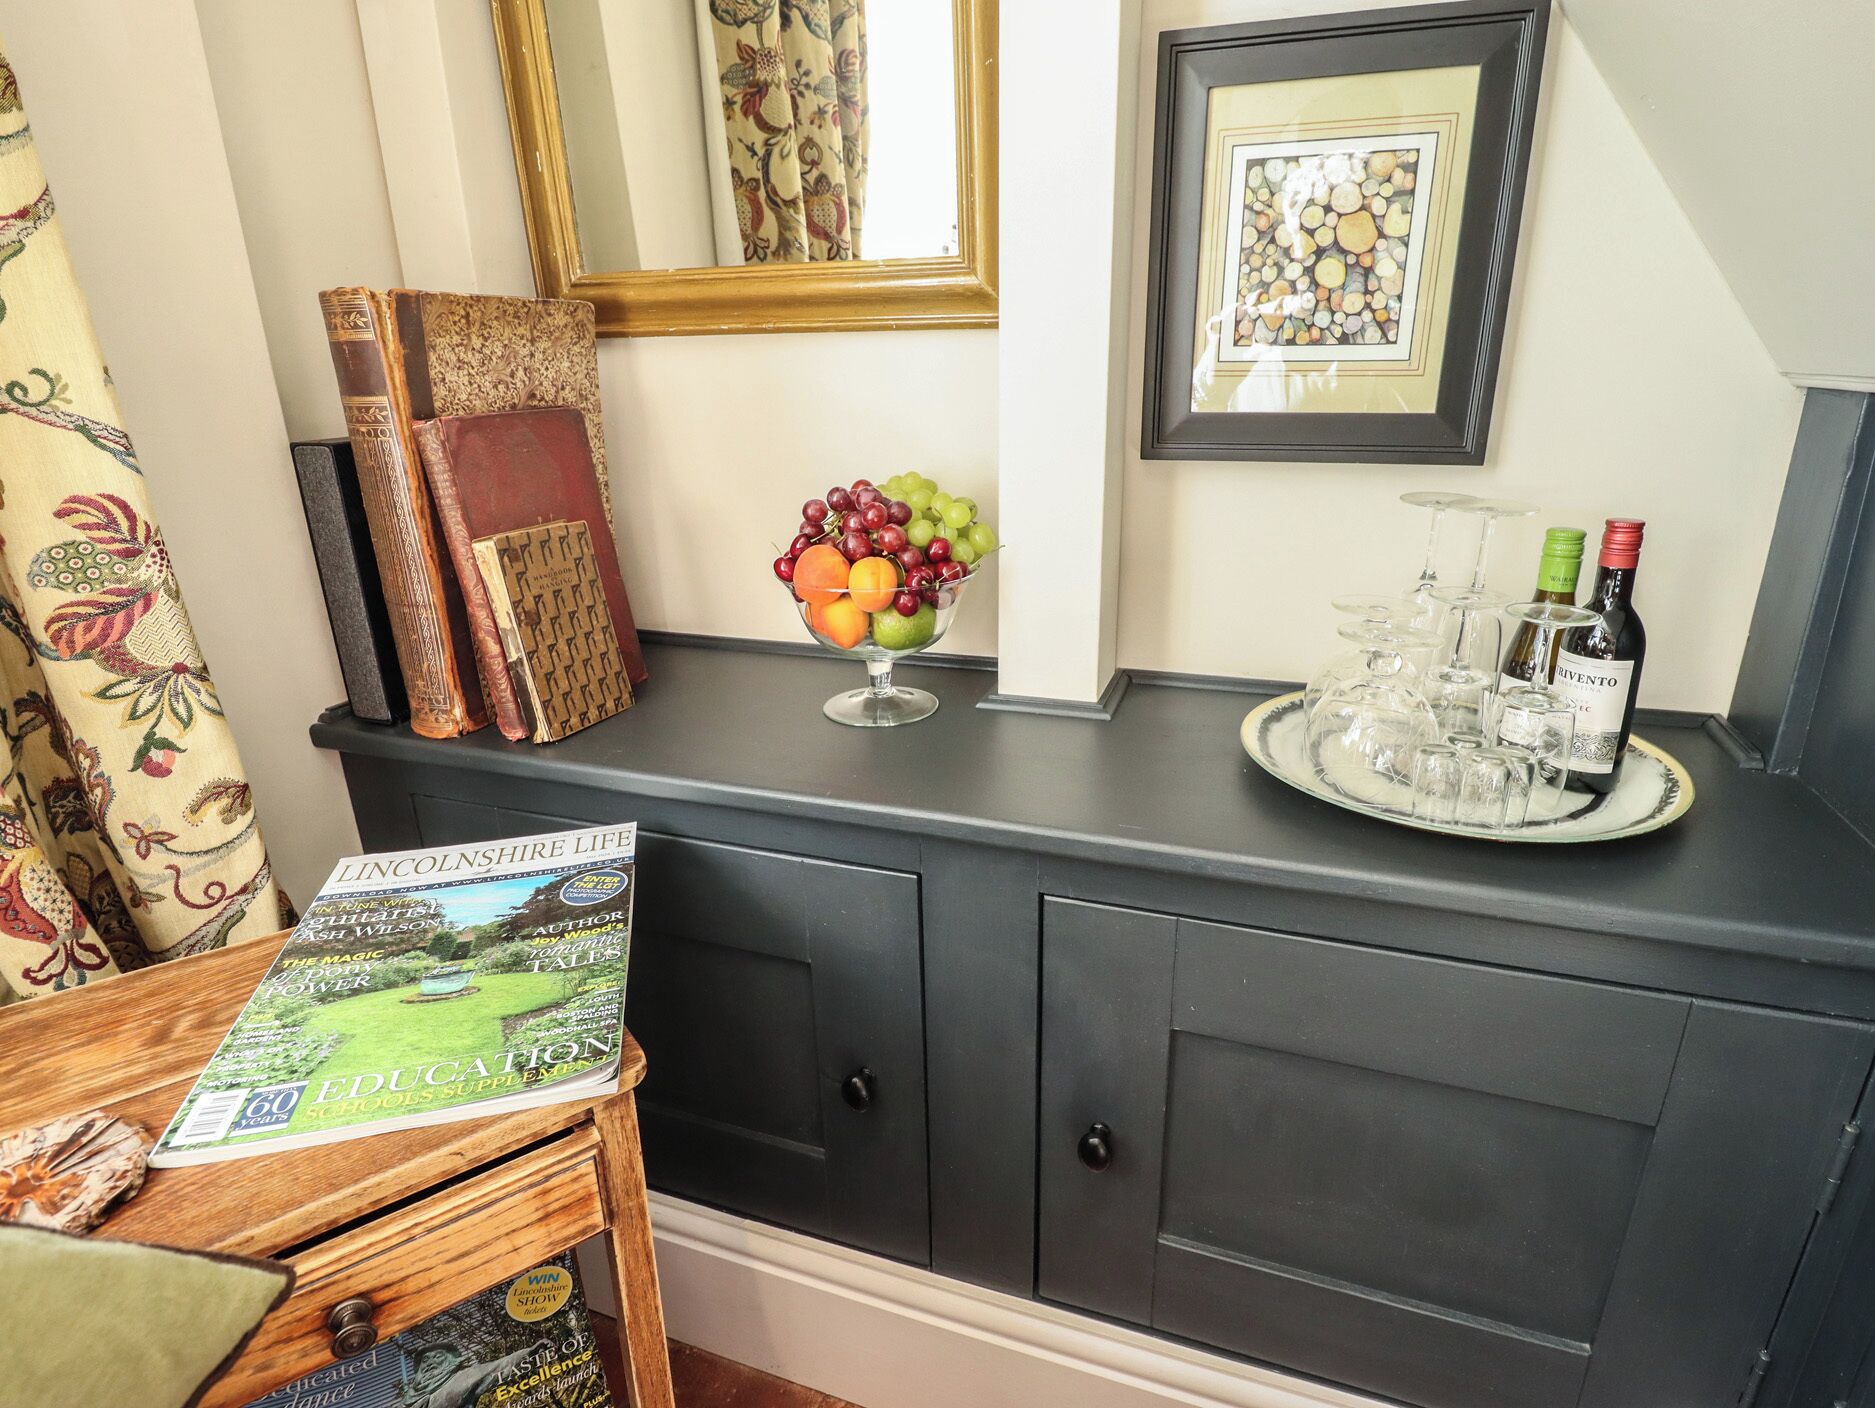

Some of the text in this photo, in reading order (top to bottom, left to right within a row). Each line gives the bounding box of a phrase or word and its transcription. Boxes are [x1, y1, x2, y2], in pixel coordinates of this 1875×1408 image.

[533, 567, 573, 581] HANDBOOK
[539, 577, 573, 590] HANGING
[336, 839, 566, 882] LINCOLNSHIRE
[573, 830, 632, 855] LIFE
[573, 881, 597, 889] THE
[582, 875, 621, 883] ENTER
[323, 889, 393, 900] DOWNLOAD
[399, 885, 428, 893] NOW
[432, 881, 446, 889] AT
[306, 898, 439, 932] guitarist
[315, 906, 334, 914] IN
[338, 902, 380, 912] TUNE
[532, 911, 625, 936] AUTHOR
[297, 929, 348, 943] ASH
[530, 921, 625, 946] Joy Wood's
[529, 931, 624, 959] romantic
[282, 949, 386, 969] THE MAGIC
[526, 947, 622, 973] TALES
[271, 961, 383, 986] of pony
[264, 976, 372, 999] POWER
[589, 993, 620, 1004] LOUTH
[557, 1006, 596, 1019] BOSTON
[571, 1008, 619, 1021] SPALDING
[541, 1018, 618, 1036] WOODHALL SPA
[311, 1034, 616, 1105] EDUCATION
[207, 1074, 269, 1087] MOTORING
[304, 1054, 608, 1121] SCHOOLS SUPPLEMENT
[246, 1089, 299, 1117] 60
[235, 1112, 289, 1131] years
[528, 1272, 560, 1285] WIN
[513, 1283, 568, 1297] Lincolnshire
[517, 1292, 560, 1307] SHOW
[524, 1305, 547, 1316] tickets
[492, 1332, 590, 1385] TASTE OF
[261, 1350, 378, 1400] edicated
[495, 1349, 593, 1401] Excellence
[556, 1361, 600, 1390] launch
